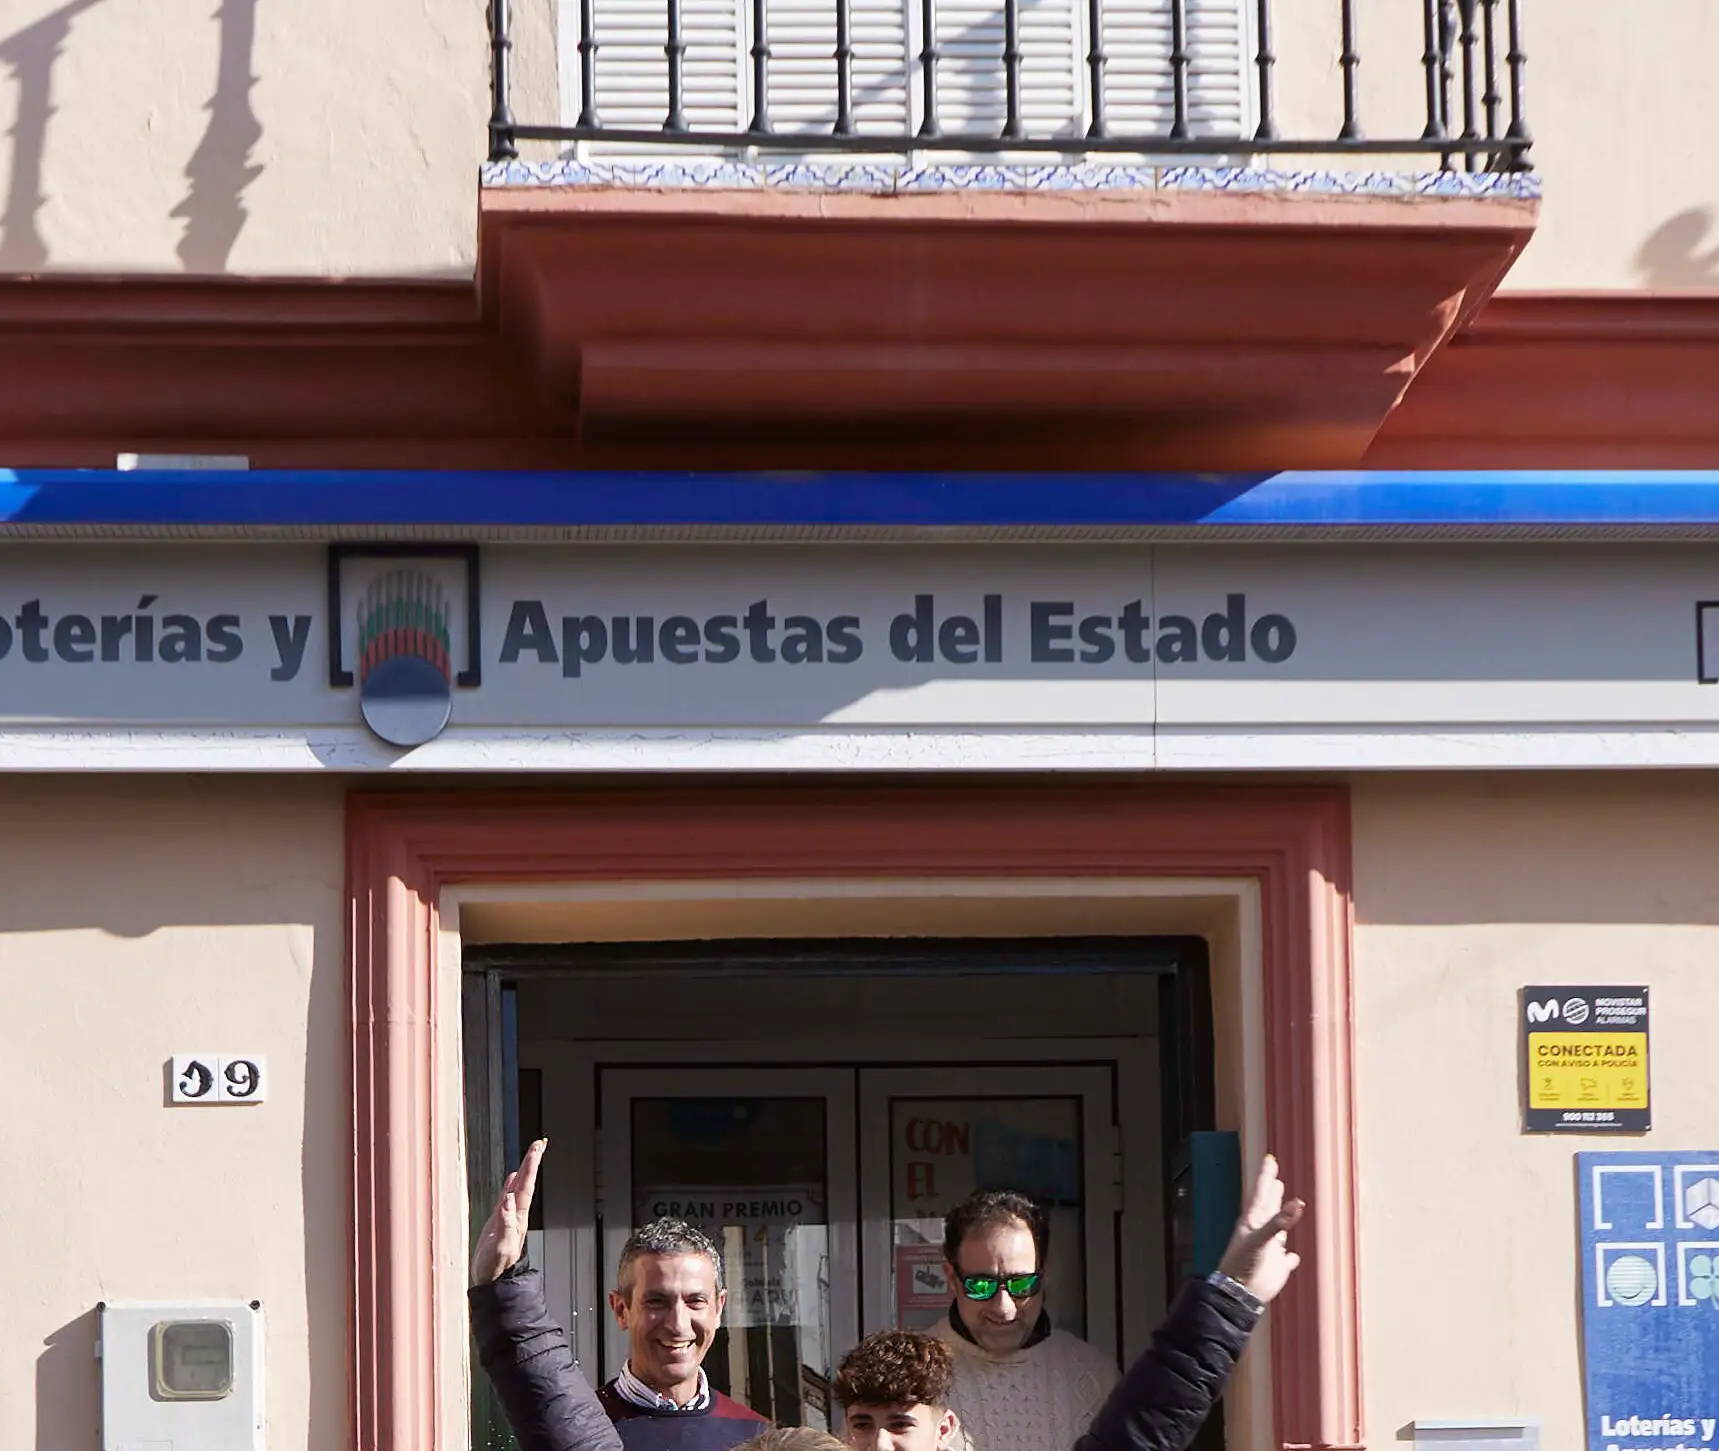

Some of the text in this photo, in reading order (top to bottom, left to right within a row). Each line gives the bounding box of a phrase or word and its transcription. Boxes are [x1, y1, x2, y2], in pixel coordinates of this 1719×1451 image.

[269, 613, 312, 681] y
[498, 599, 863, 677] Apuestas
[888, 594, 1003, 664] del
[1030, 594, 1297, 664] Estado
[1537, 1044, 1639, 1057] CONECTADA
[905, 1116, 970, 1156] CON
[906, 1161, 940, 1202] EL
[652, 1199, 804, 1219] GRAN PREMIO
[1600, 1413, 1716, 1440] Loterías y
